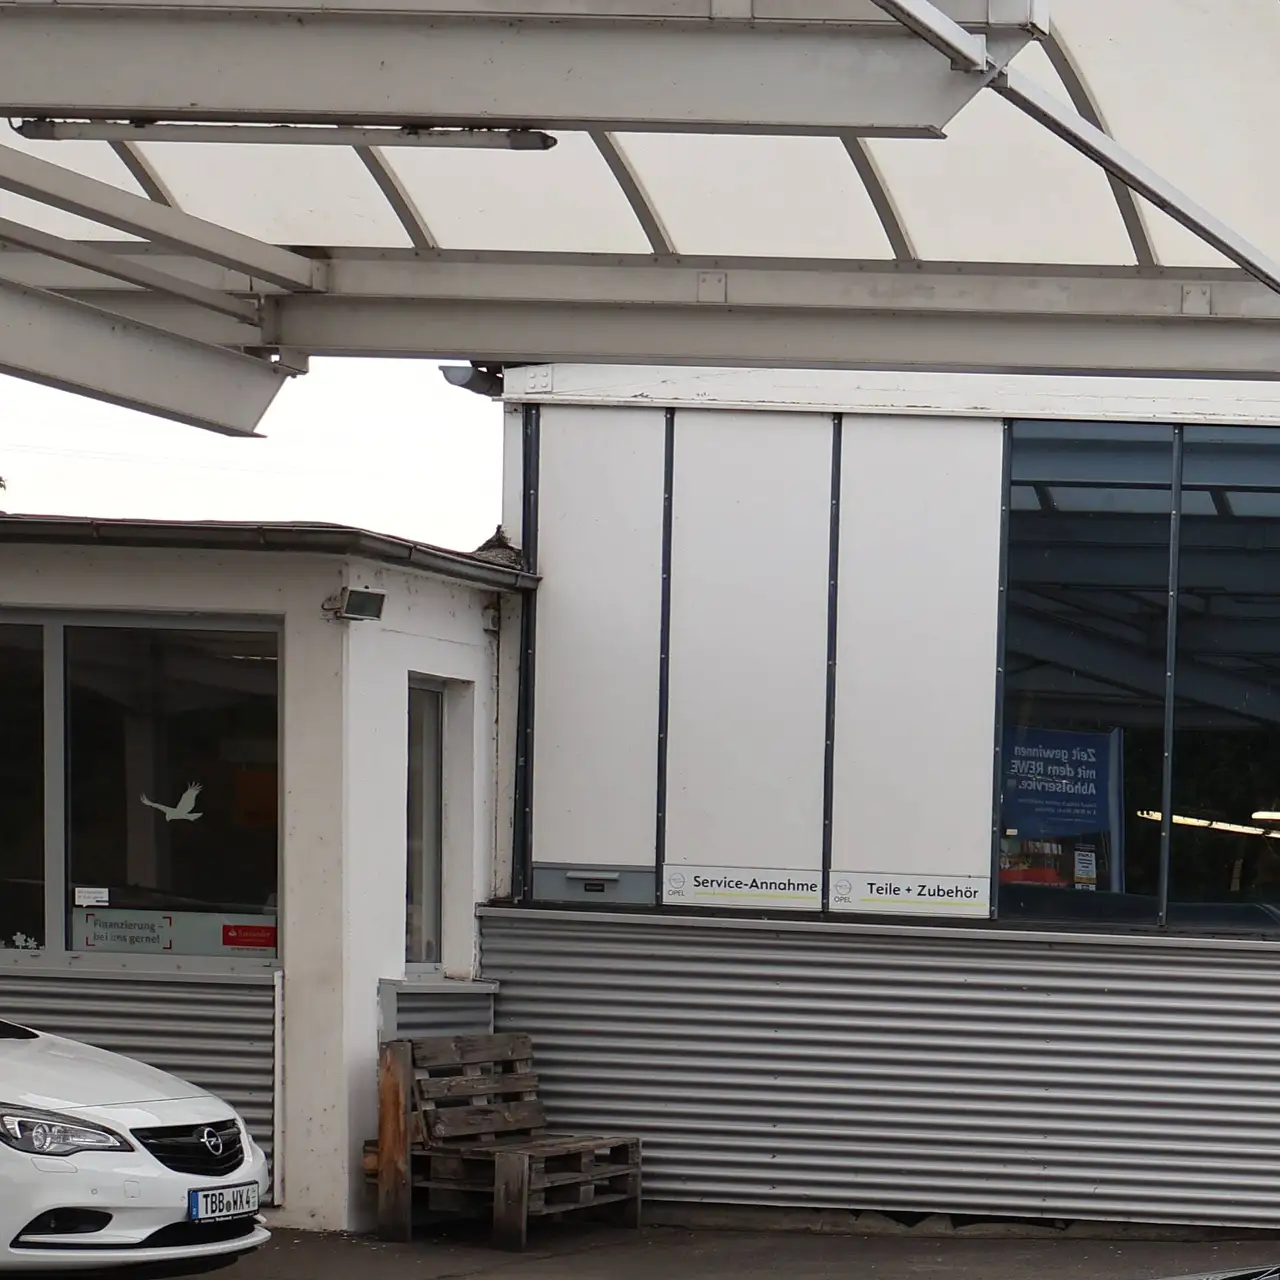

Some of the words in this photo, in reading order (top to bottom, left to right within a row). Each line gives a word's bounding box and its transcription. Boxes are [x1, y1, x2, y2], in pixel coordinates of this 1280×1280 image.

[693, 876, 818, 892] Service-Annahme
[867, 882, 901, 896] Teile
[916, 884, 979, 899] Zubehör
[93, 919, 156, 933] Finanzierung
[203, 1192, 225, 1214] TBB
